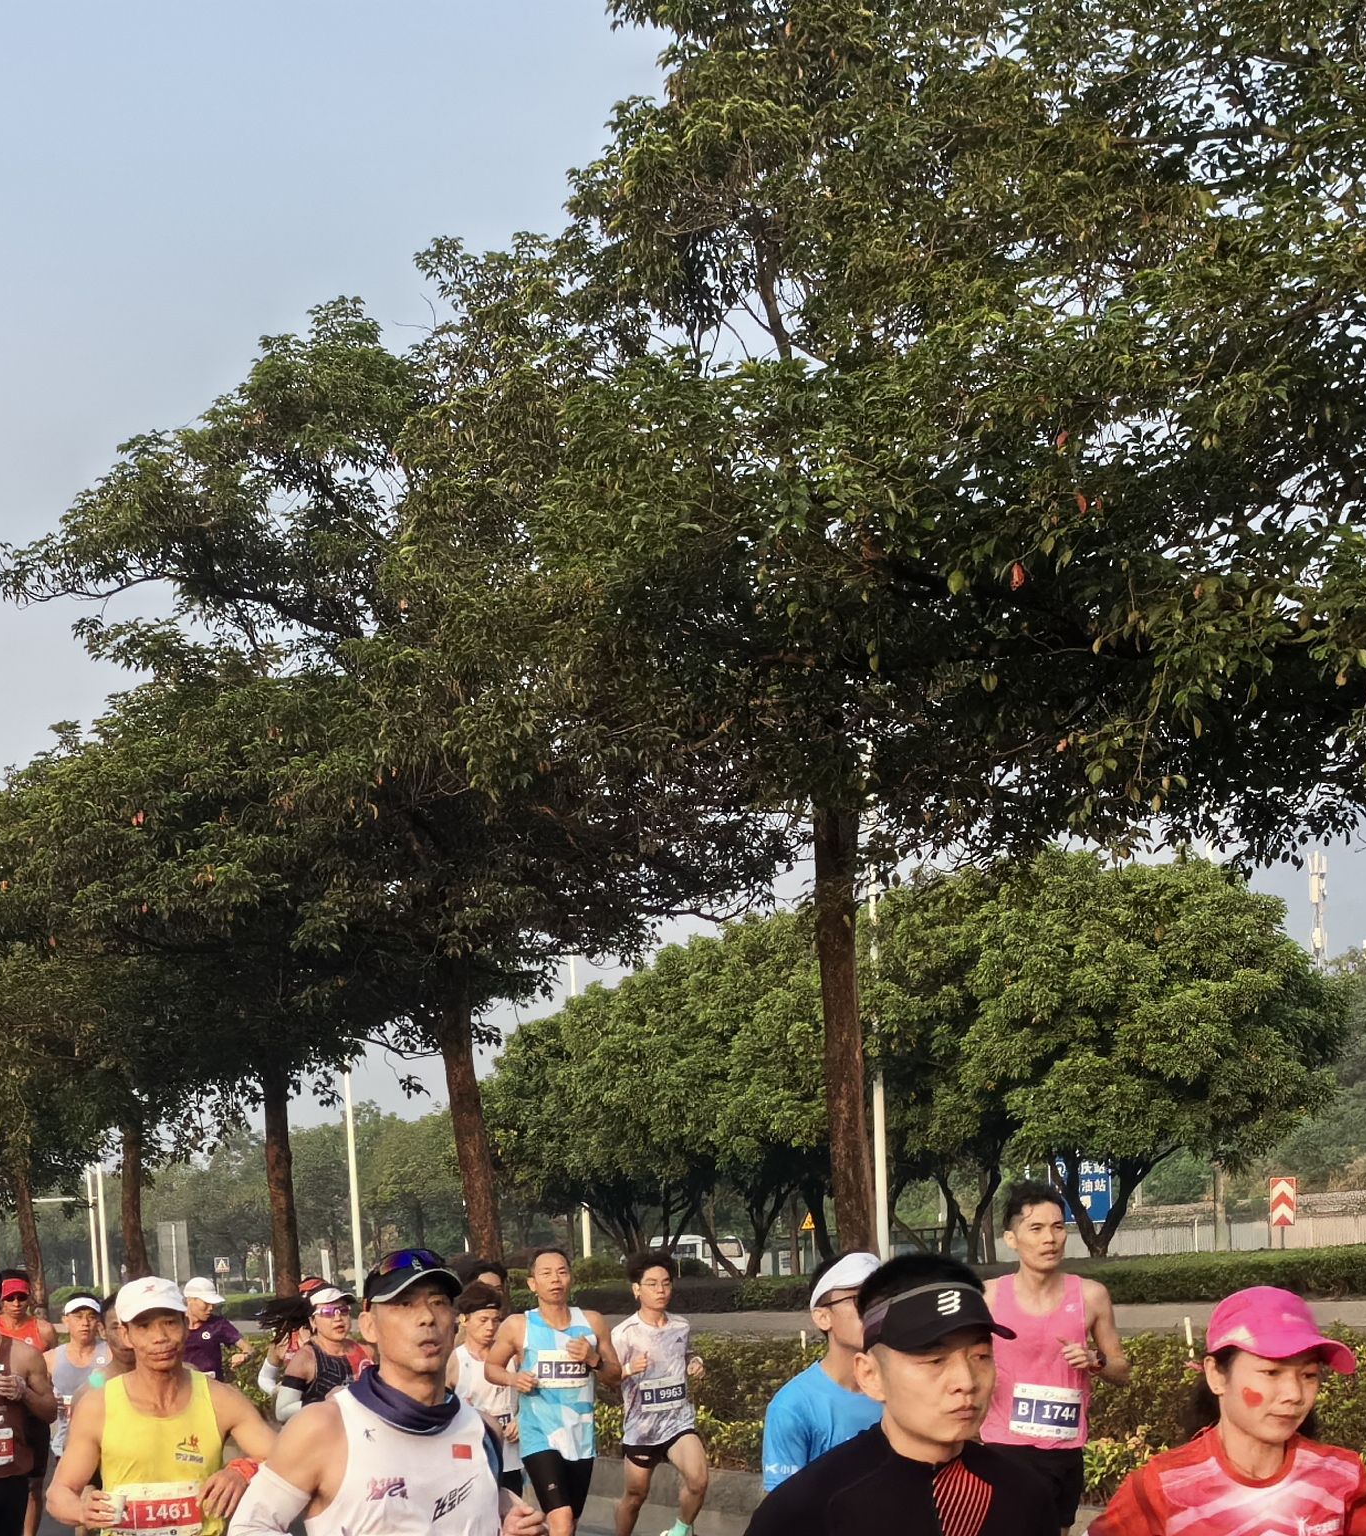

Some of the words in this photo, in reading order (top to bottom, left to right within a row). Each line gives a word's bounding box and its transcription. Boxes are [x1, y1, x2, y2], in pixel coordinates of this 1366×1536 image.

[542, 1362, 551, 1374] B
[1017, 1401, 1030, 1416] B
[1041, 1404, 1077, 1421] 1744
[146, 1502, 192, 1522] 1461
